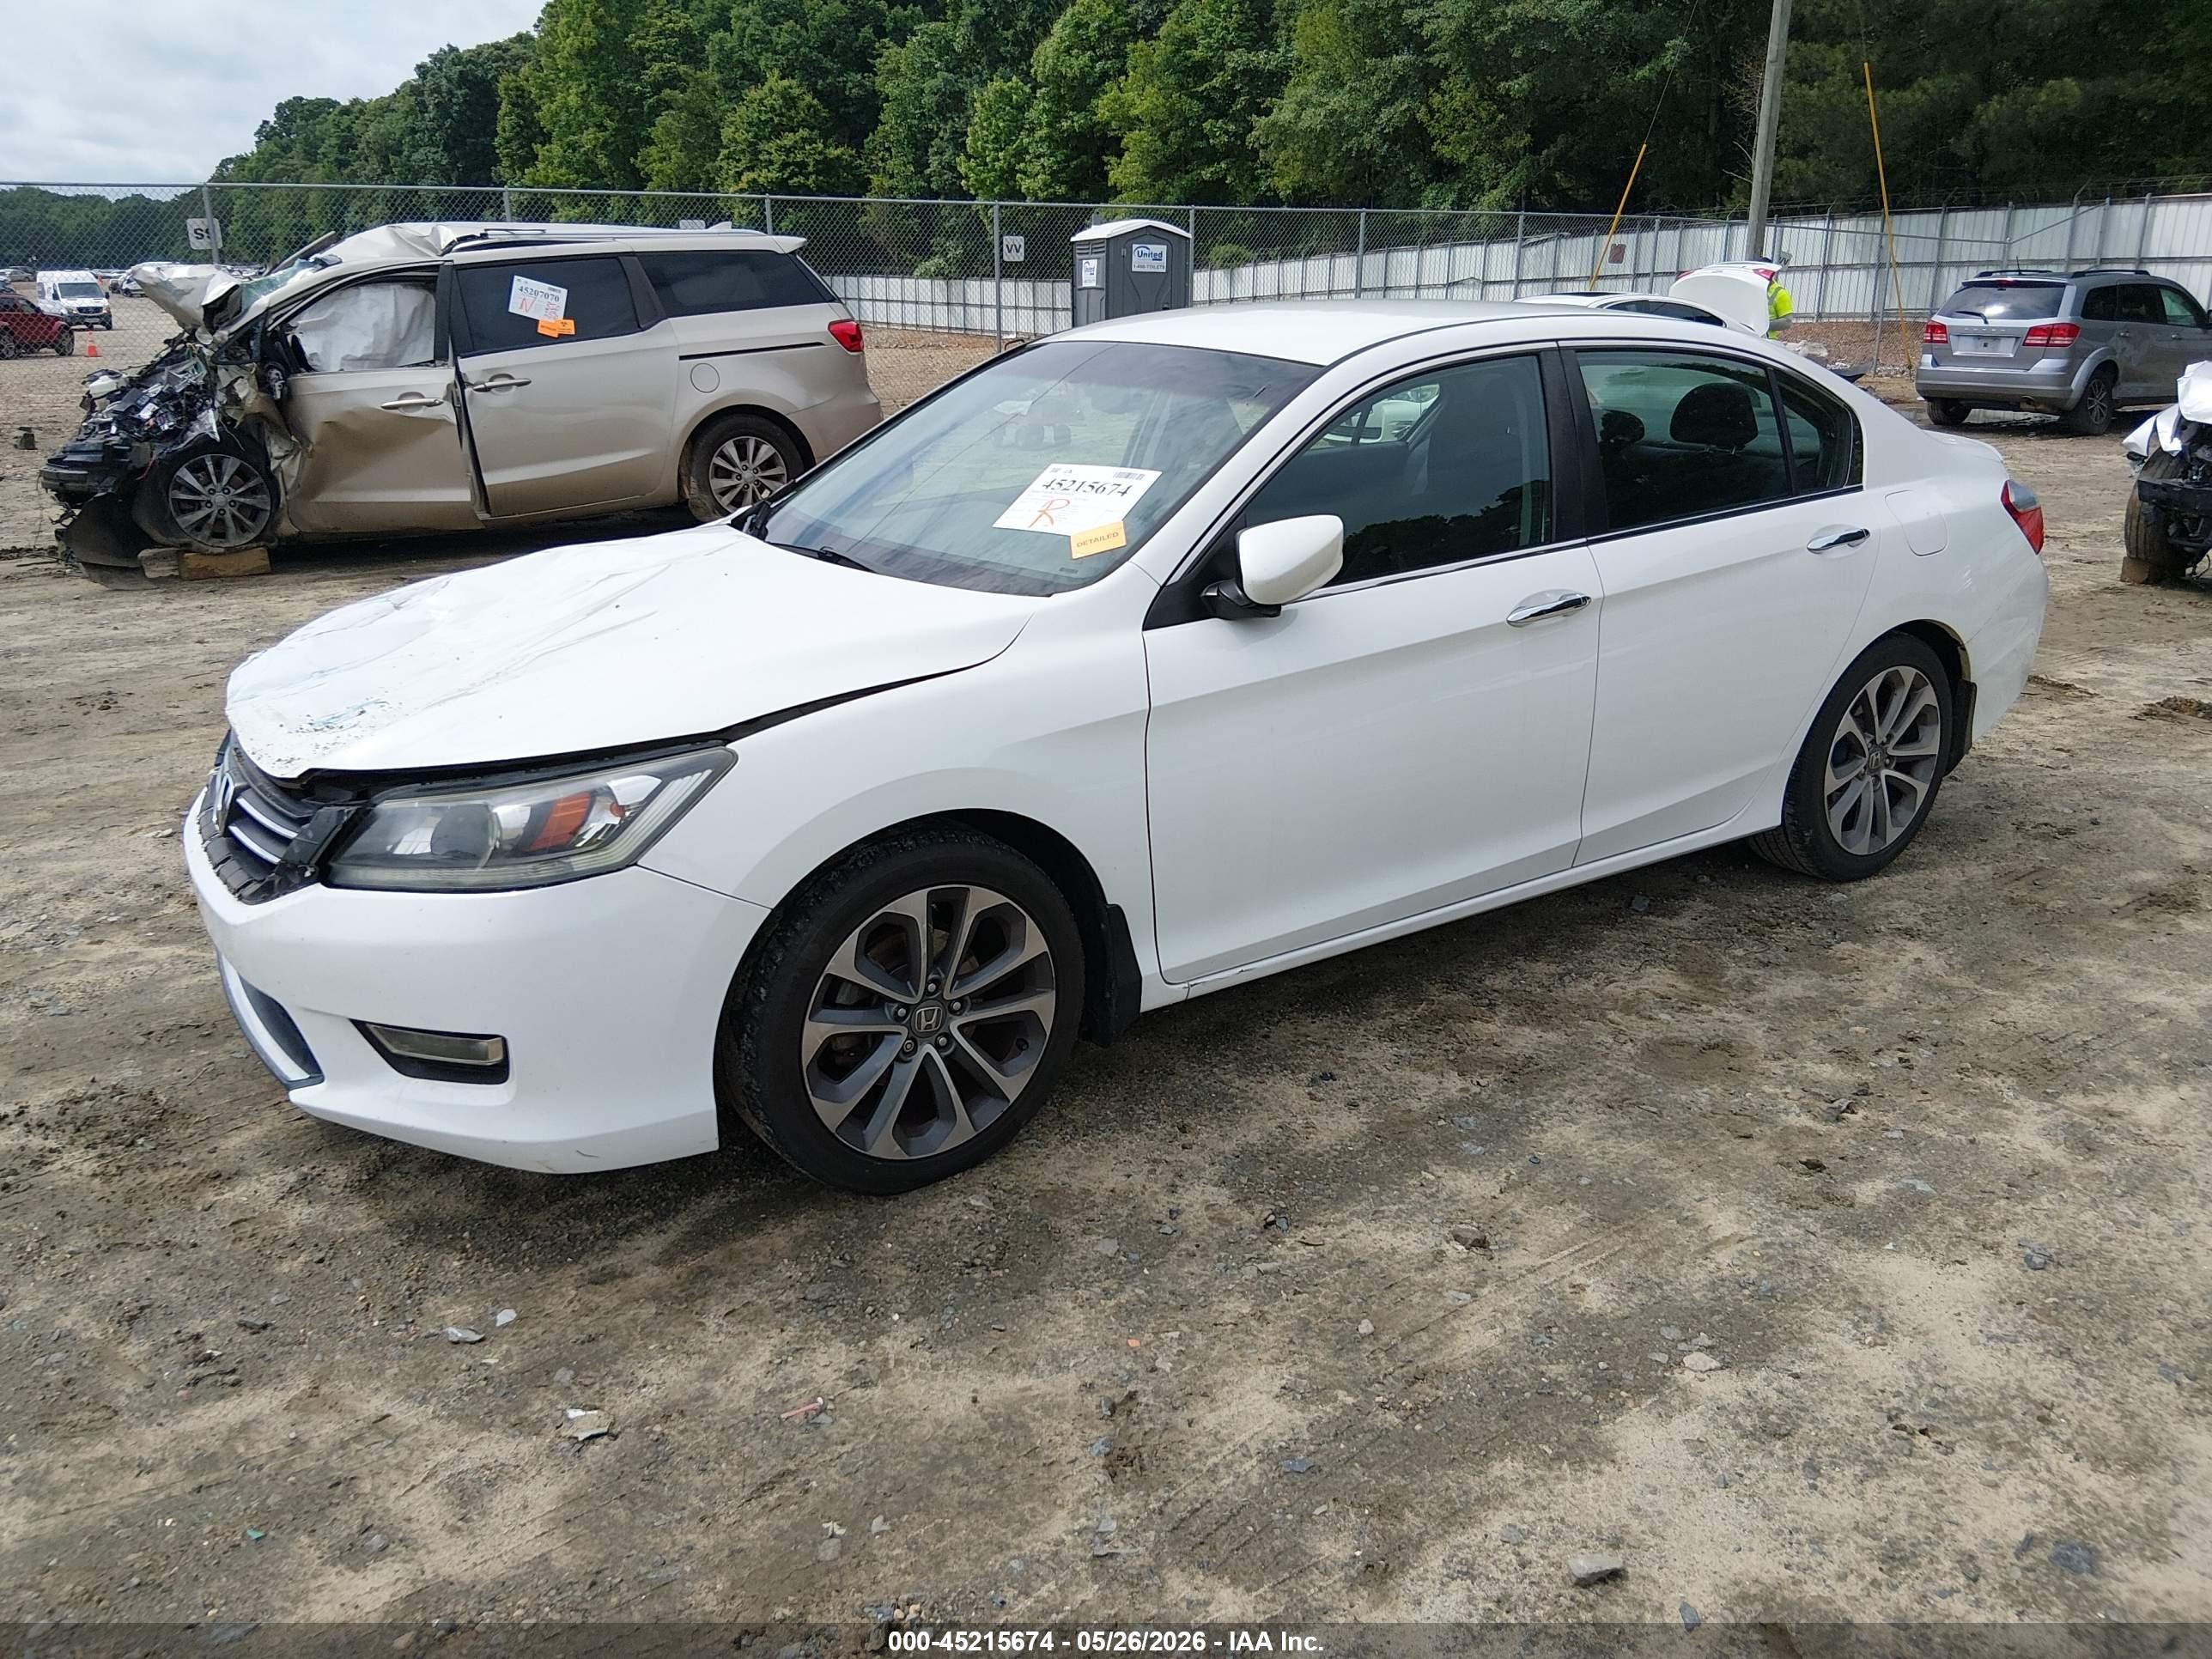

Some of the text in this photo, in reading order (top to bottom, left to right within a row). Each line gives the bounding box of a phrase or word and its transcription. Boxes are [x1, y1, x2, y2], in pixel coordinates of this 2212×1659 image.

[1137, 250, 1163, 258] United
[517, 285, 560, 302] 45207070
[1042, 477, 1133, 497] 45215674
[1028, 498, 1071, 528] R
[1076, 532, 1120, 548] DETAILED
